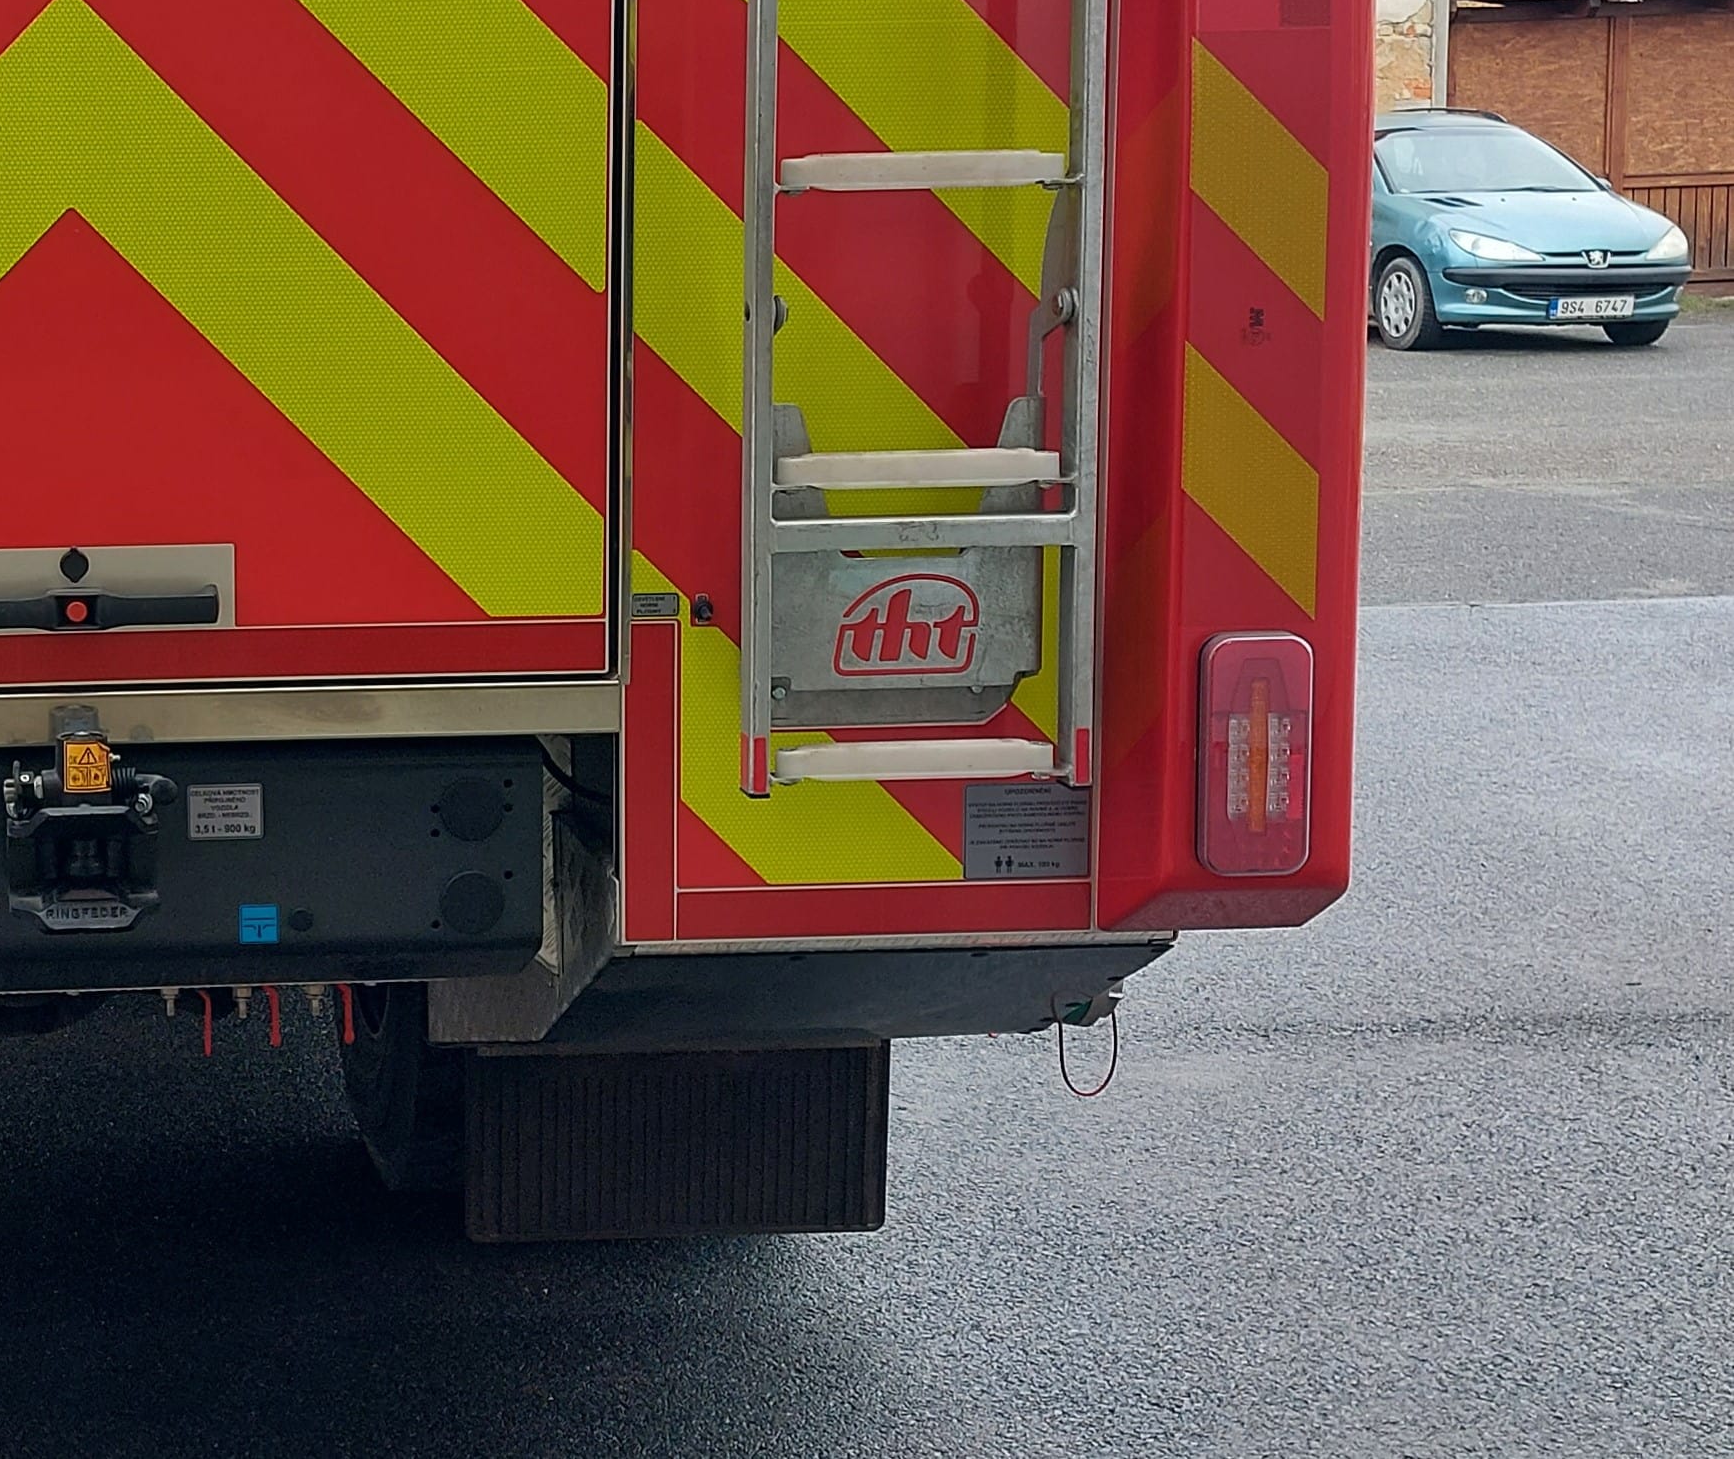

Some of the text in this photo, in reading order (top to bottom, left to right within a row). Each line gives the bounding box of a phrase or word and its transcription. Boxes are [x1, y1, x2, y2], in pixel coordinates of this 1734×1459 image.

[1561, 299, 1628, 315] 9S4 6747
[244, 823, 256, 835] kg
[45, 906, 130, 919] RINGFEDER
